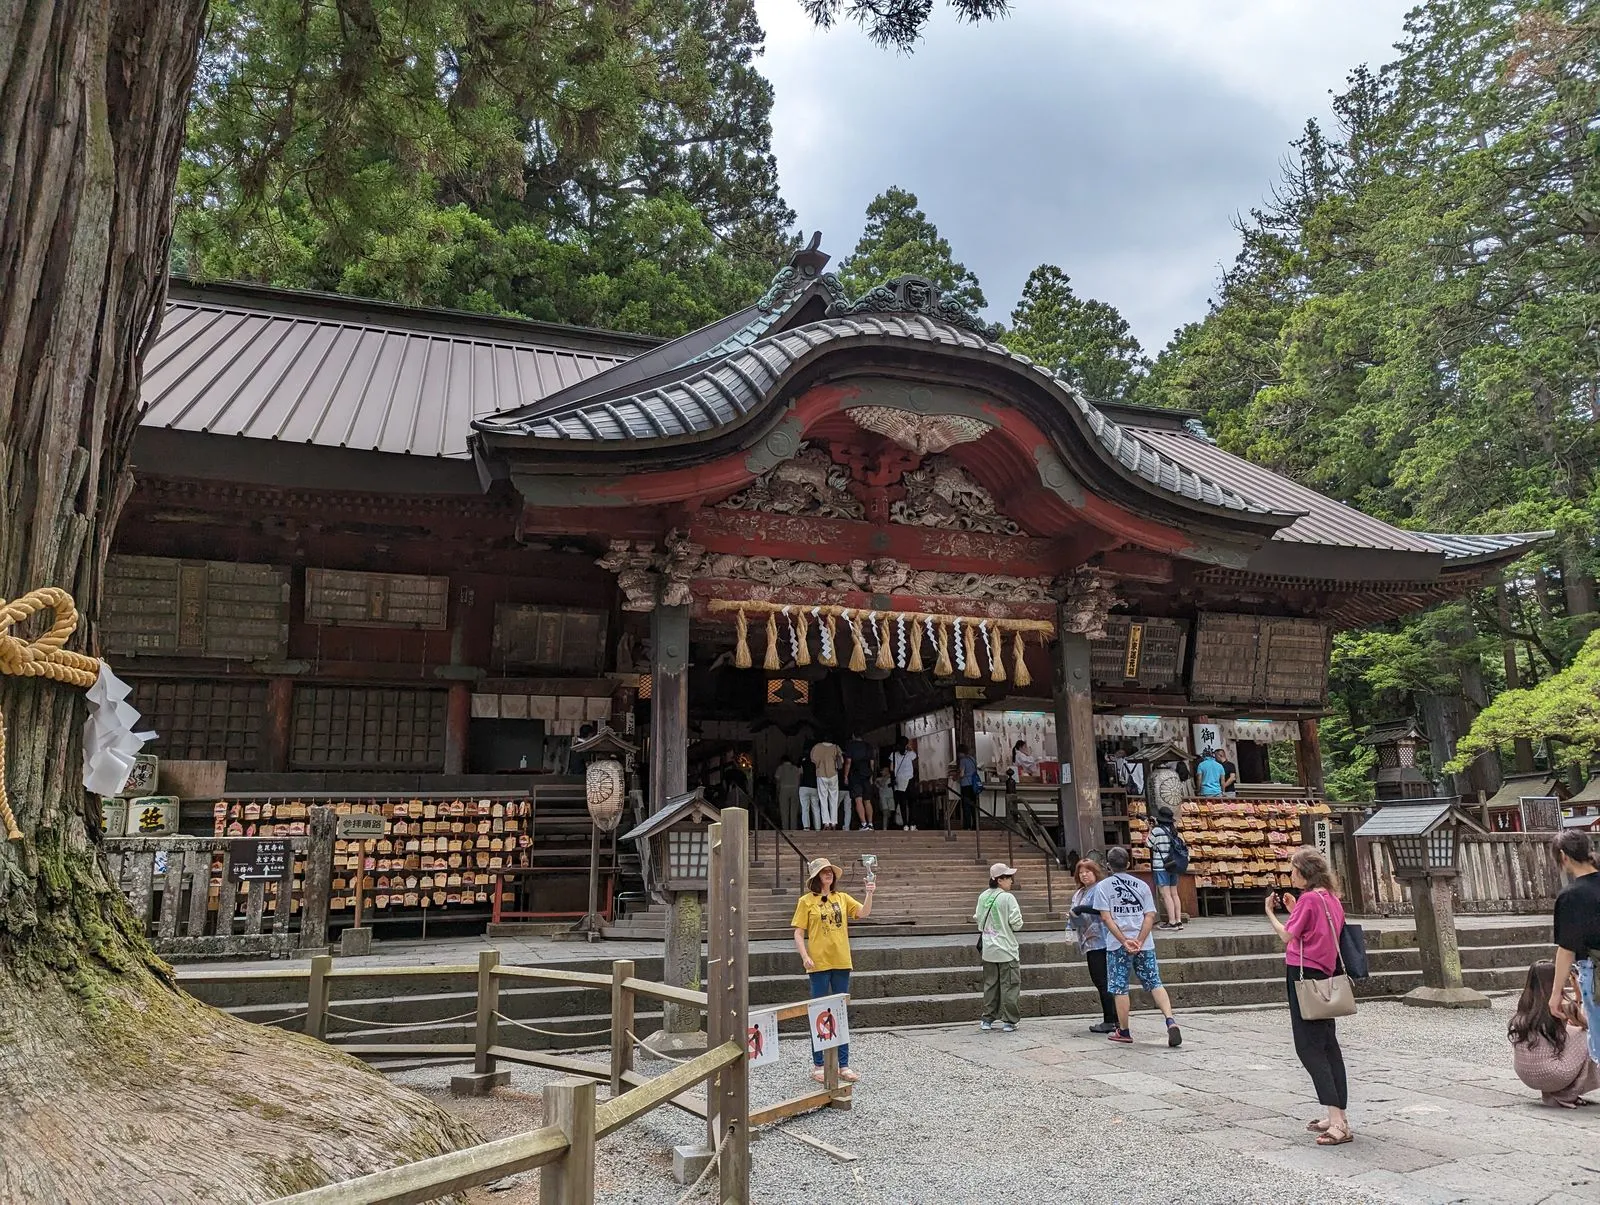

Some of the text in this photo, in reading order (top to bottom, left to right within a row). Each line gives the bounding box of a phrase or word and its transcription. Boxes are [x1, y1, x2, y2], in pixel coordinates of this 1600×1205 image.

[342, 817, 382, 829] 参拝順路
[1317, 822, 1327, 858] 防犯カメ
[255, 855, 284, 863] 東宮本殿
